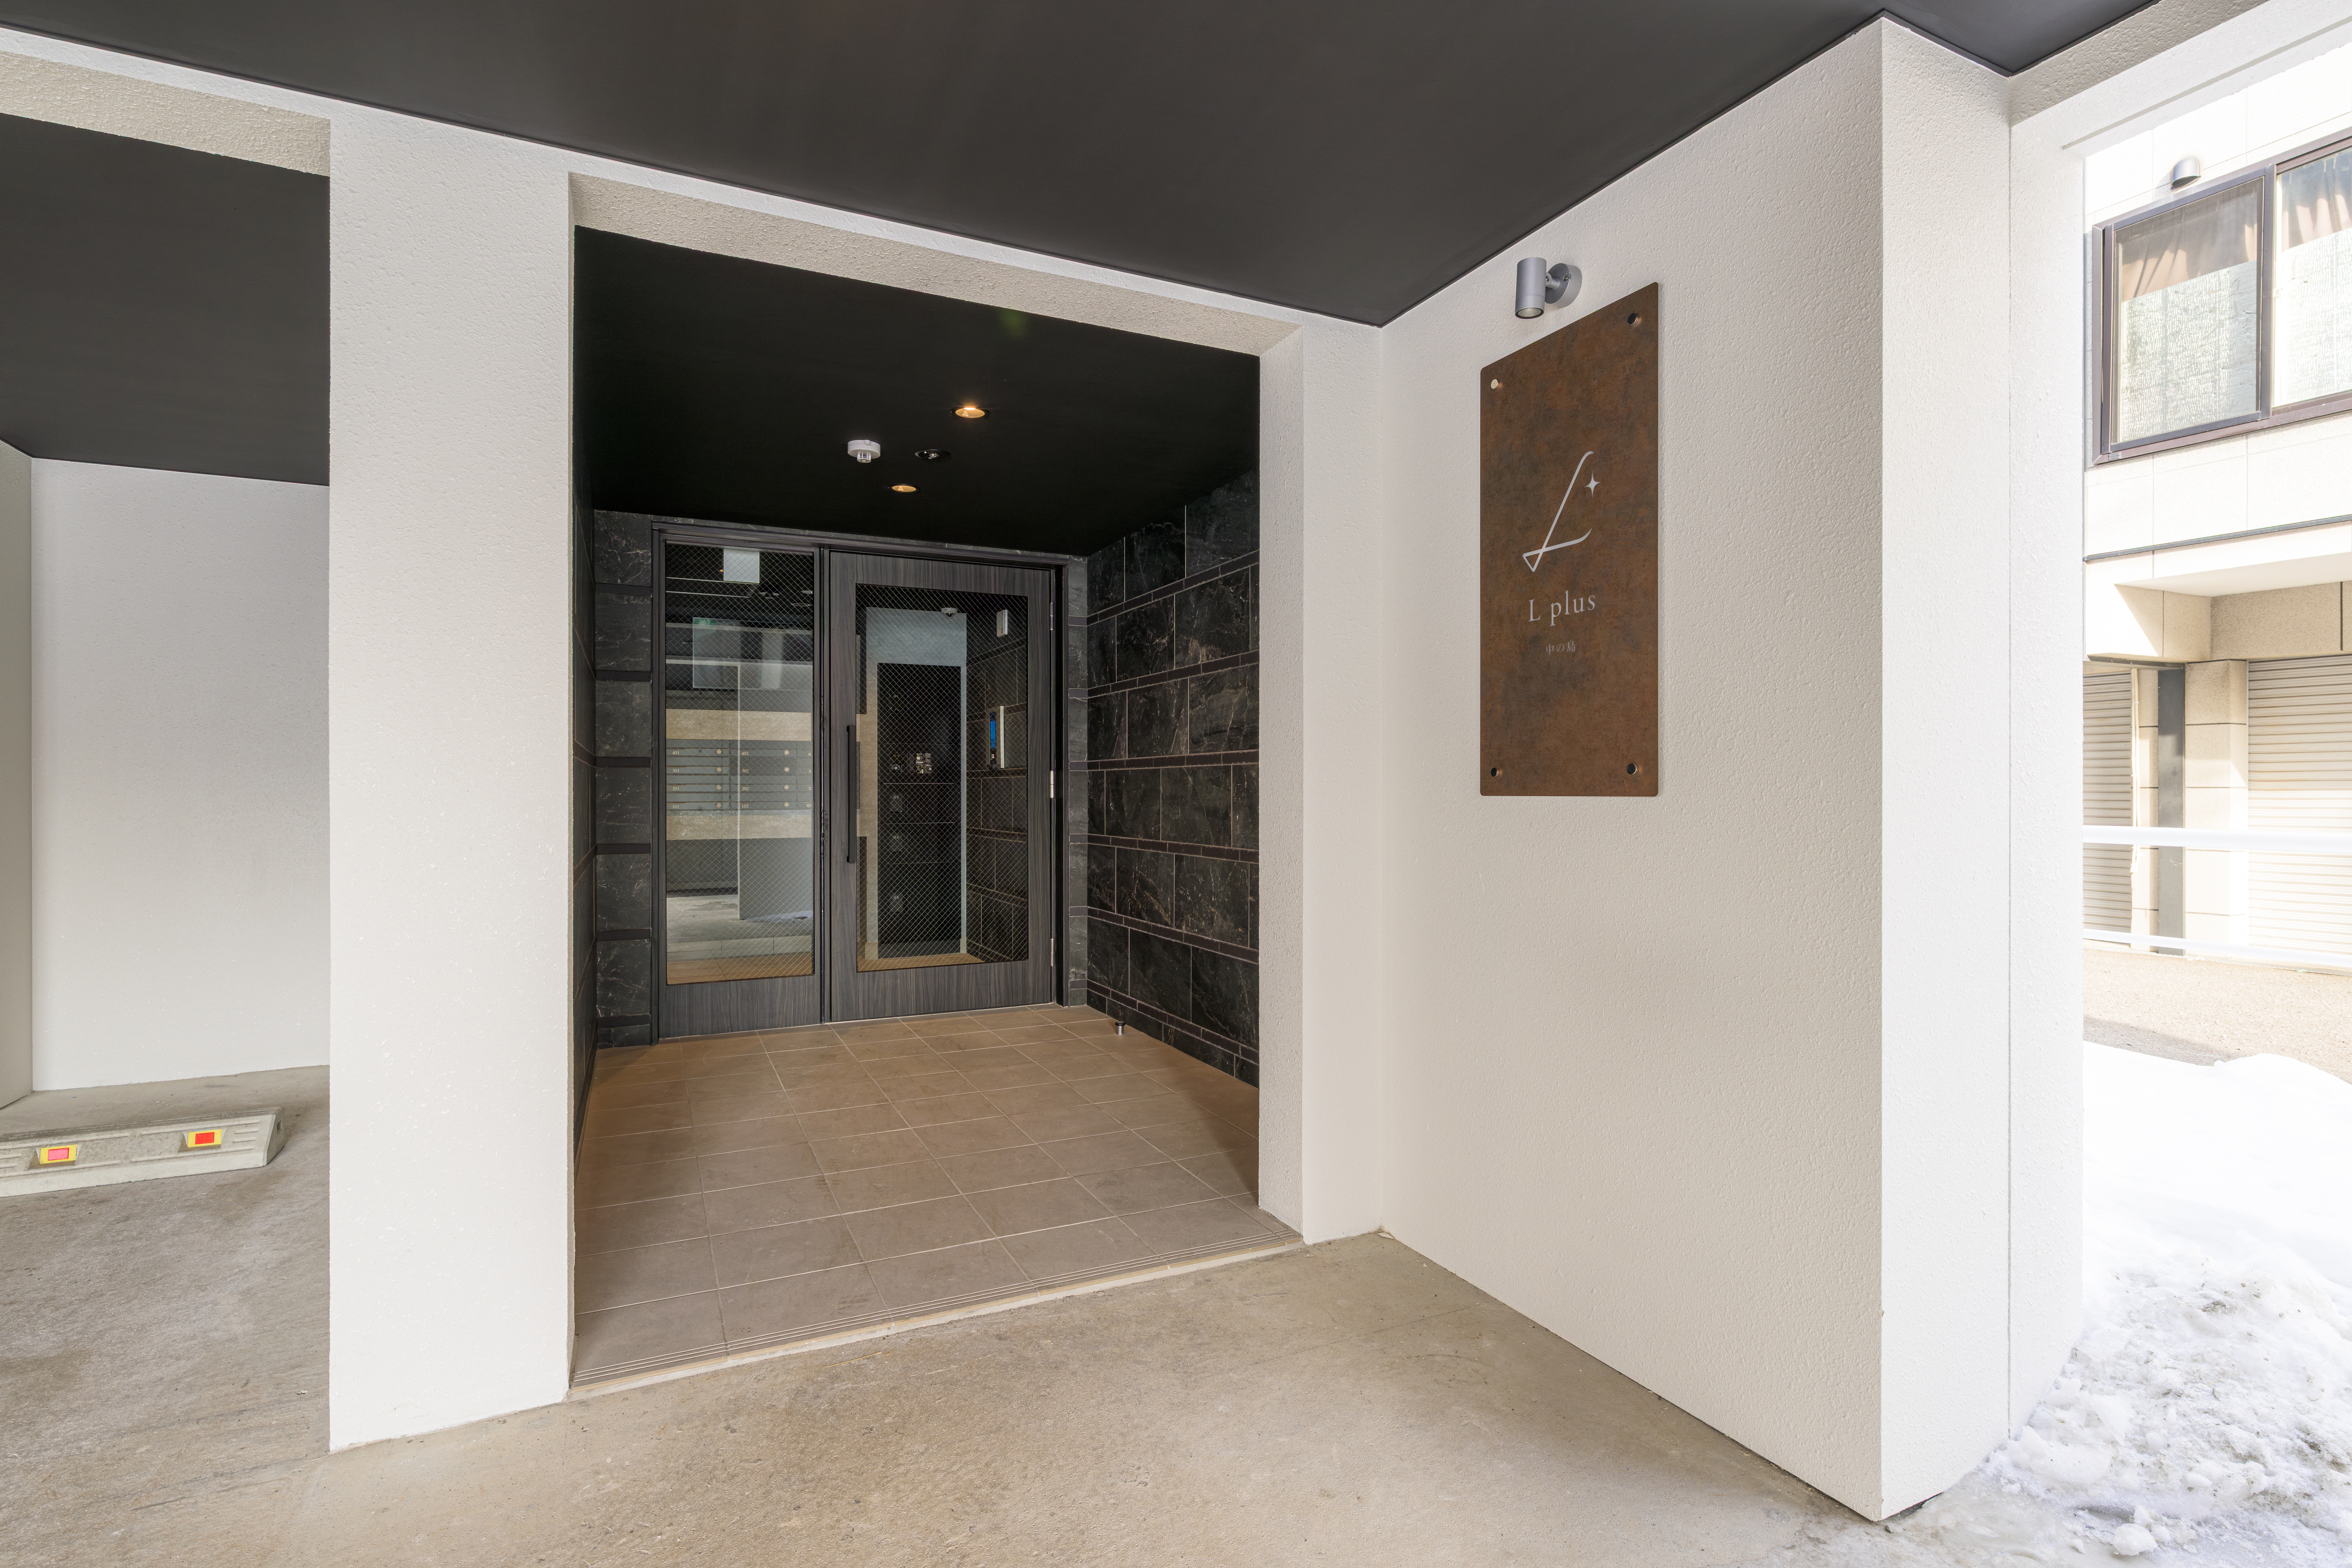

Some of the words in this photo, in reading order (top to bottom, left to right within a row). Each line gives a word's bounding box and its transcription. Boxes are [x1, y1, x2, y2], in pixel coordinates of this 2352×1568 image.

[1528, 599, 1541, 622] L
[1549, 590, 1595, 626] plus
[1546, 640, 1576, 655] 中の島
